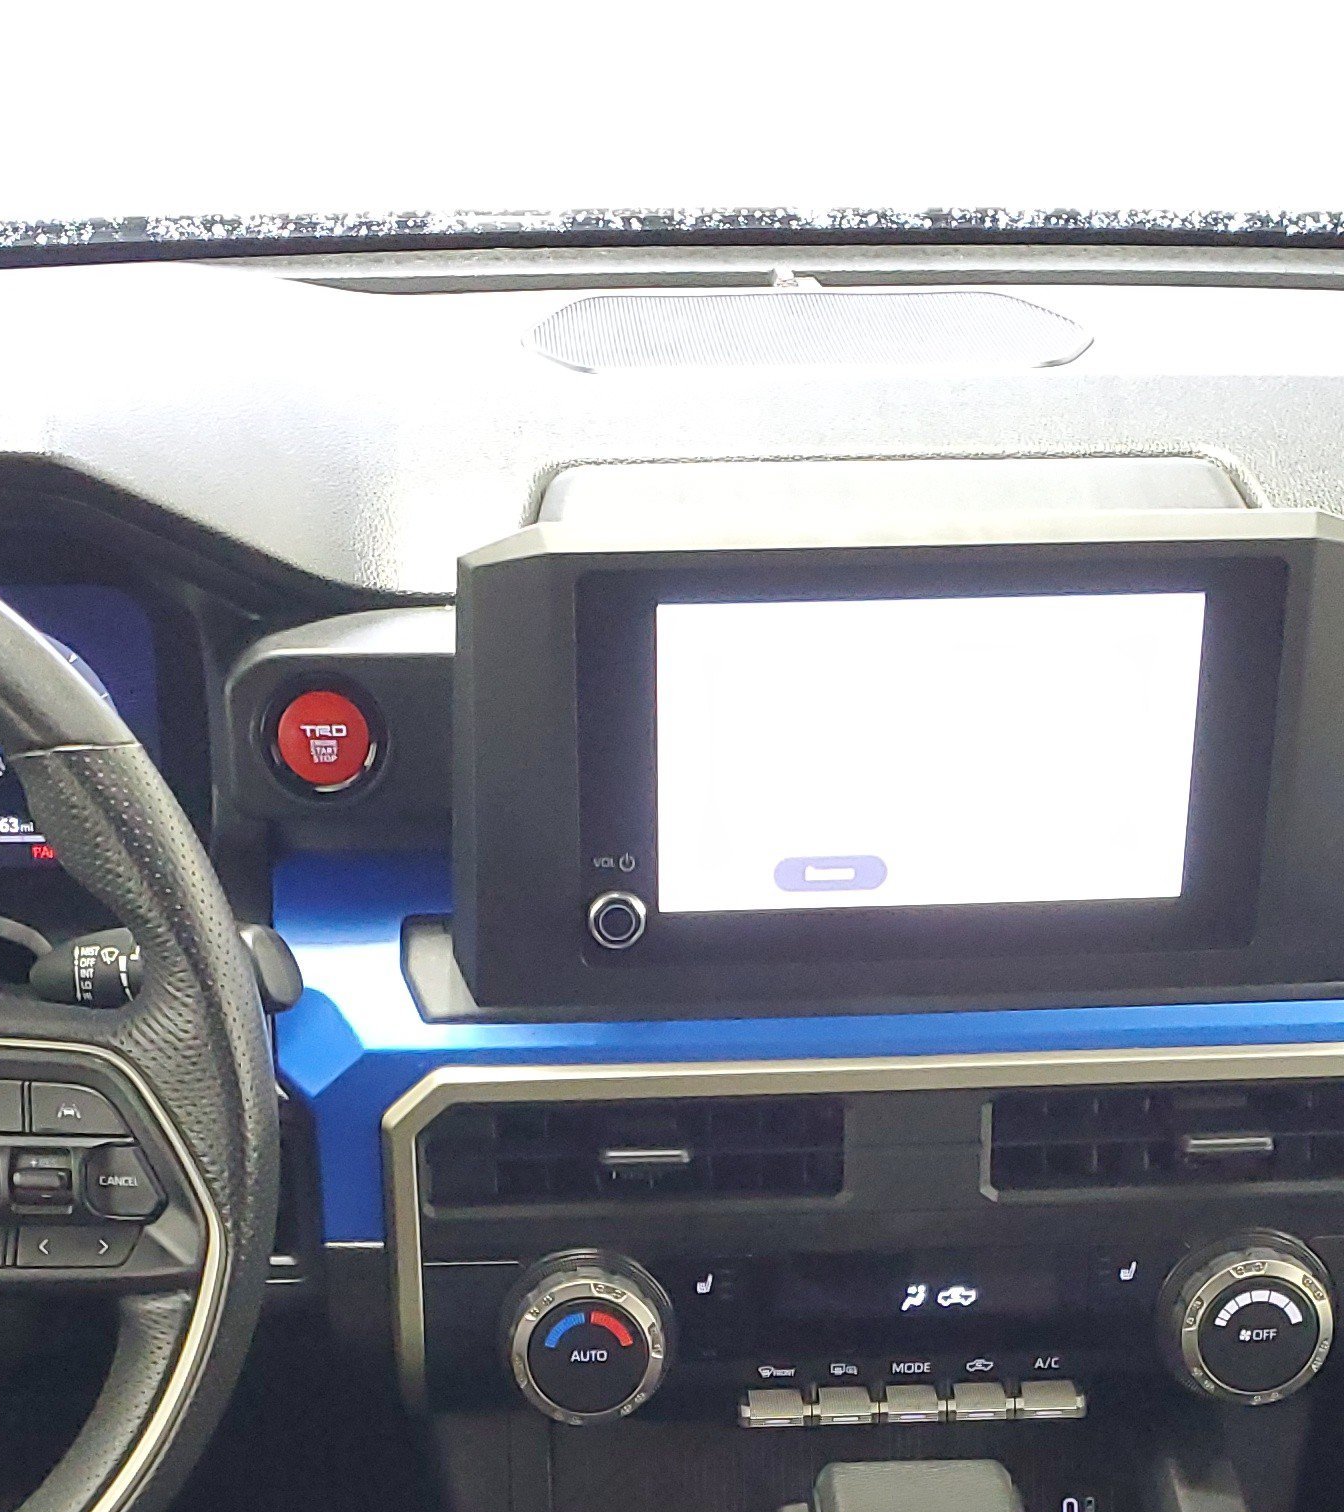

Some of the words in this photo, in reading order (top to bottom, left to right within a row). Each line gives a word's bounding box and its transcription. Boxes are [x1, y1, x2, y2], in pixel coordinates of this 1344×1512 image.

[299, 724, 347, 737] TRD
[593, 857, 616, 868] VOL
[79, 958, 96, 968] OFF
[99, 1176, 138, 1187] CANCEL
[1252, 1329, 1278, 1342] OFF
[570, 1350, 607, 1363] AUTO
[892, 1362, 931, 1375] MODE
[1034, 1357, 1060, 1370] A/C
